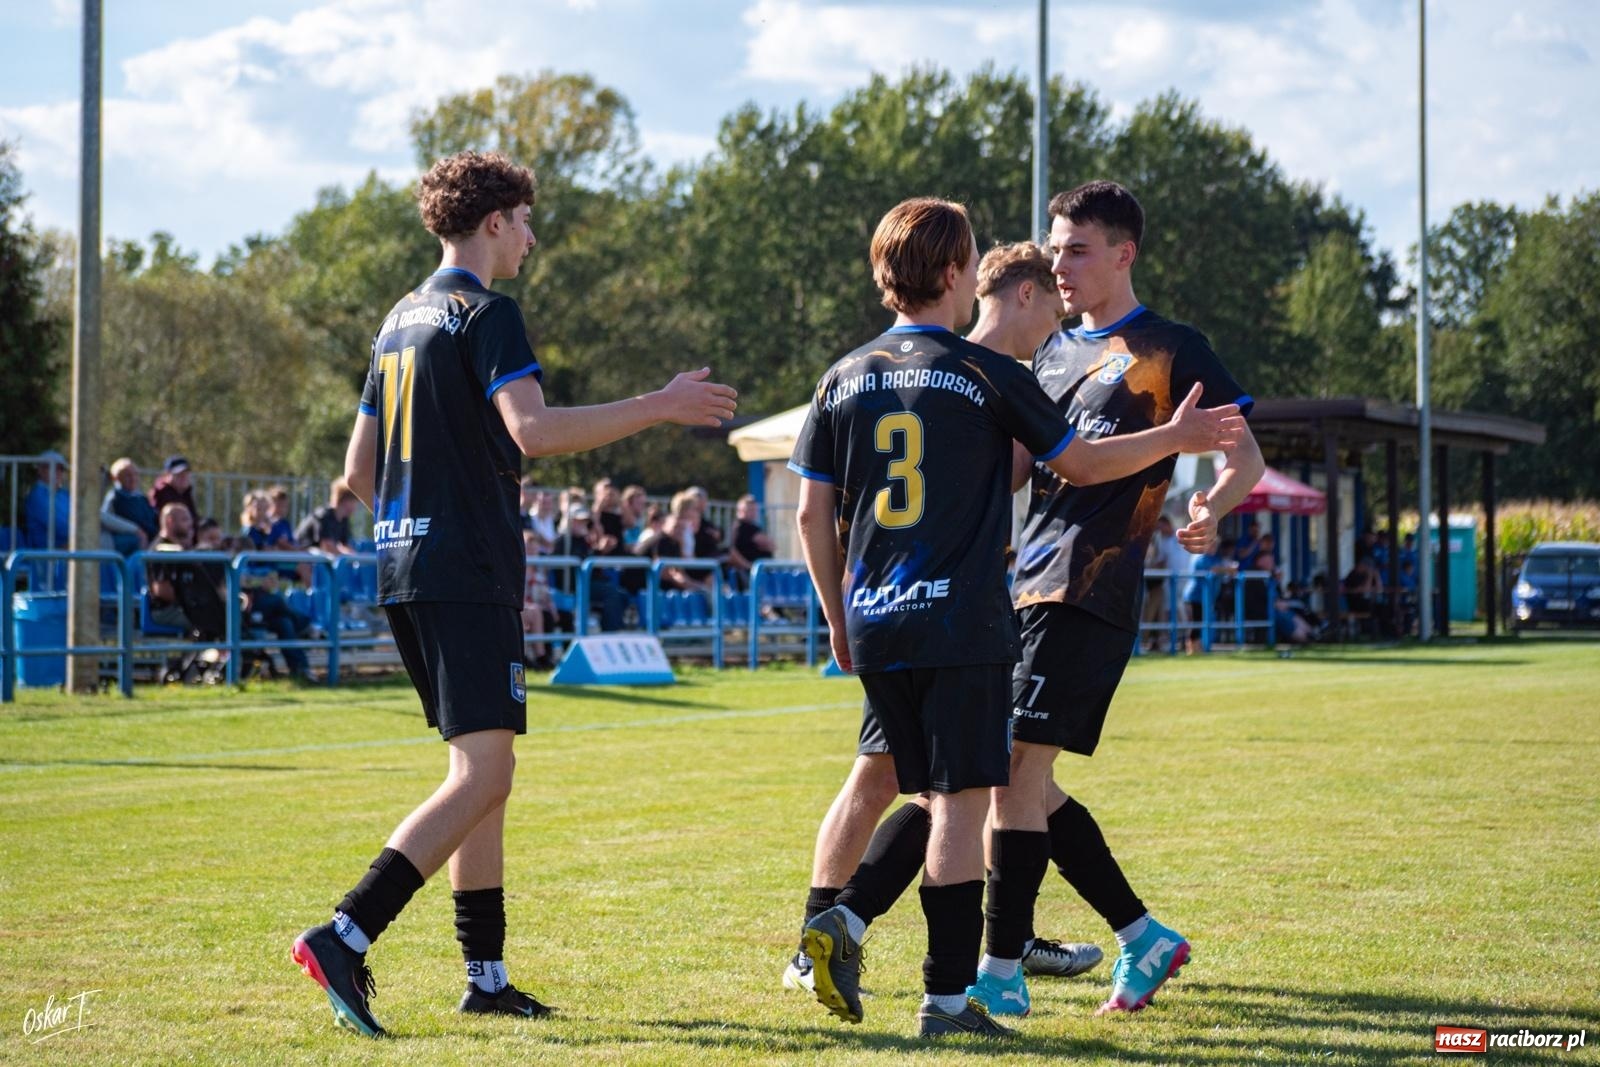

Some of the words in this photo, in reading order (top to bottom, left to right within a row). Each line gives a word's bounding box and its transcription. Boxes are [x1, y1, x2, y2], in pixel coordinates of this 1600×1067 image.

[874, 411, 925, 529] 3
[852, 578, 951, 607] CUTLINE
[888, 602, 933, 612] FACTORY
[1027, 675, 1046, 708] 7
